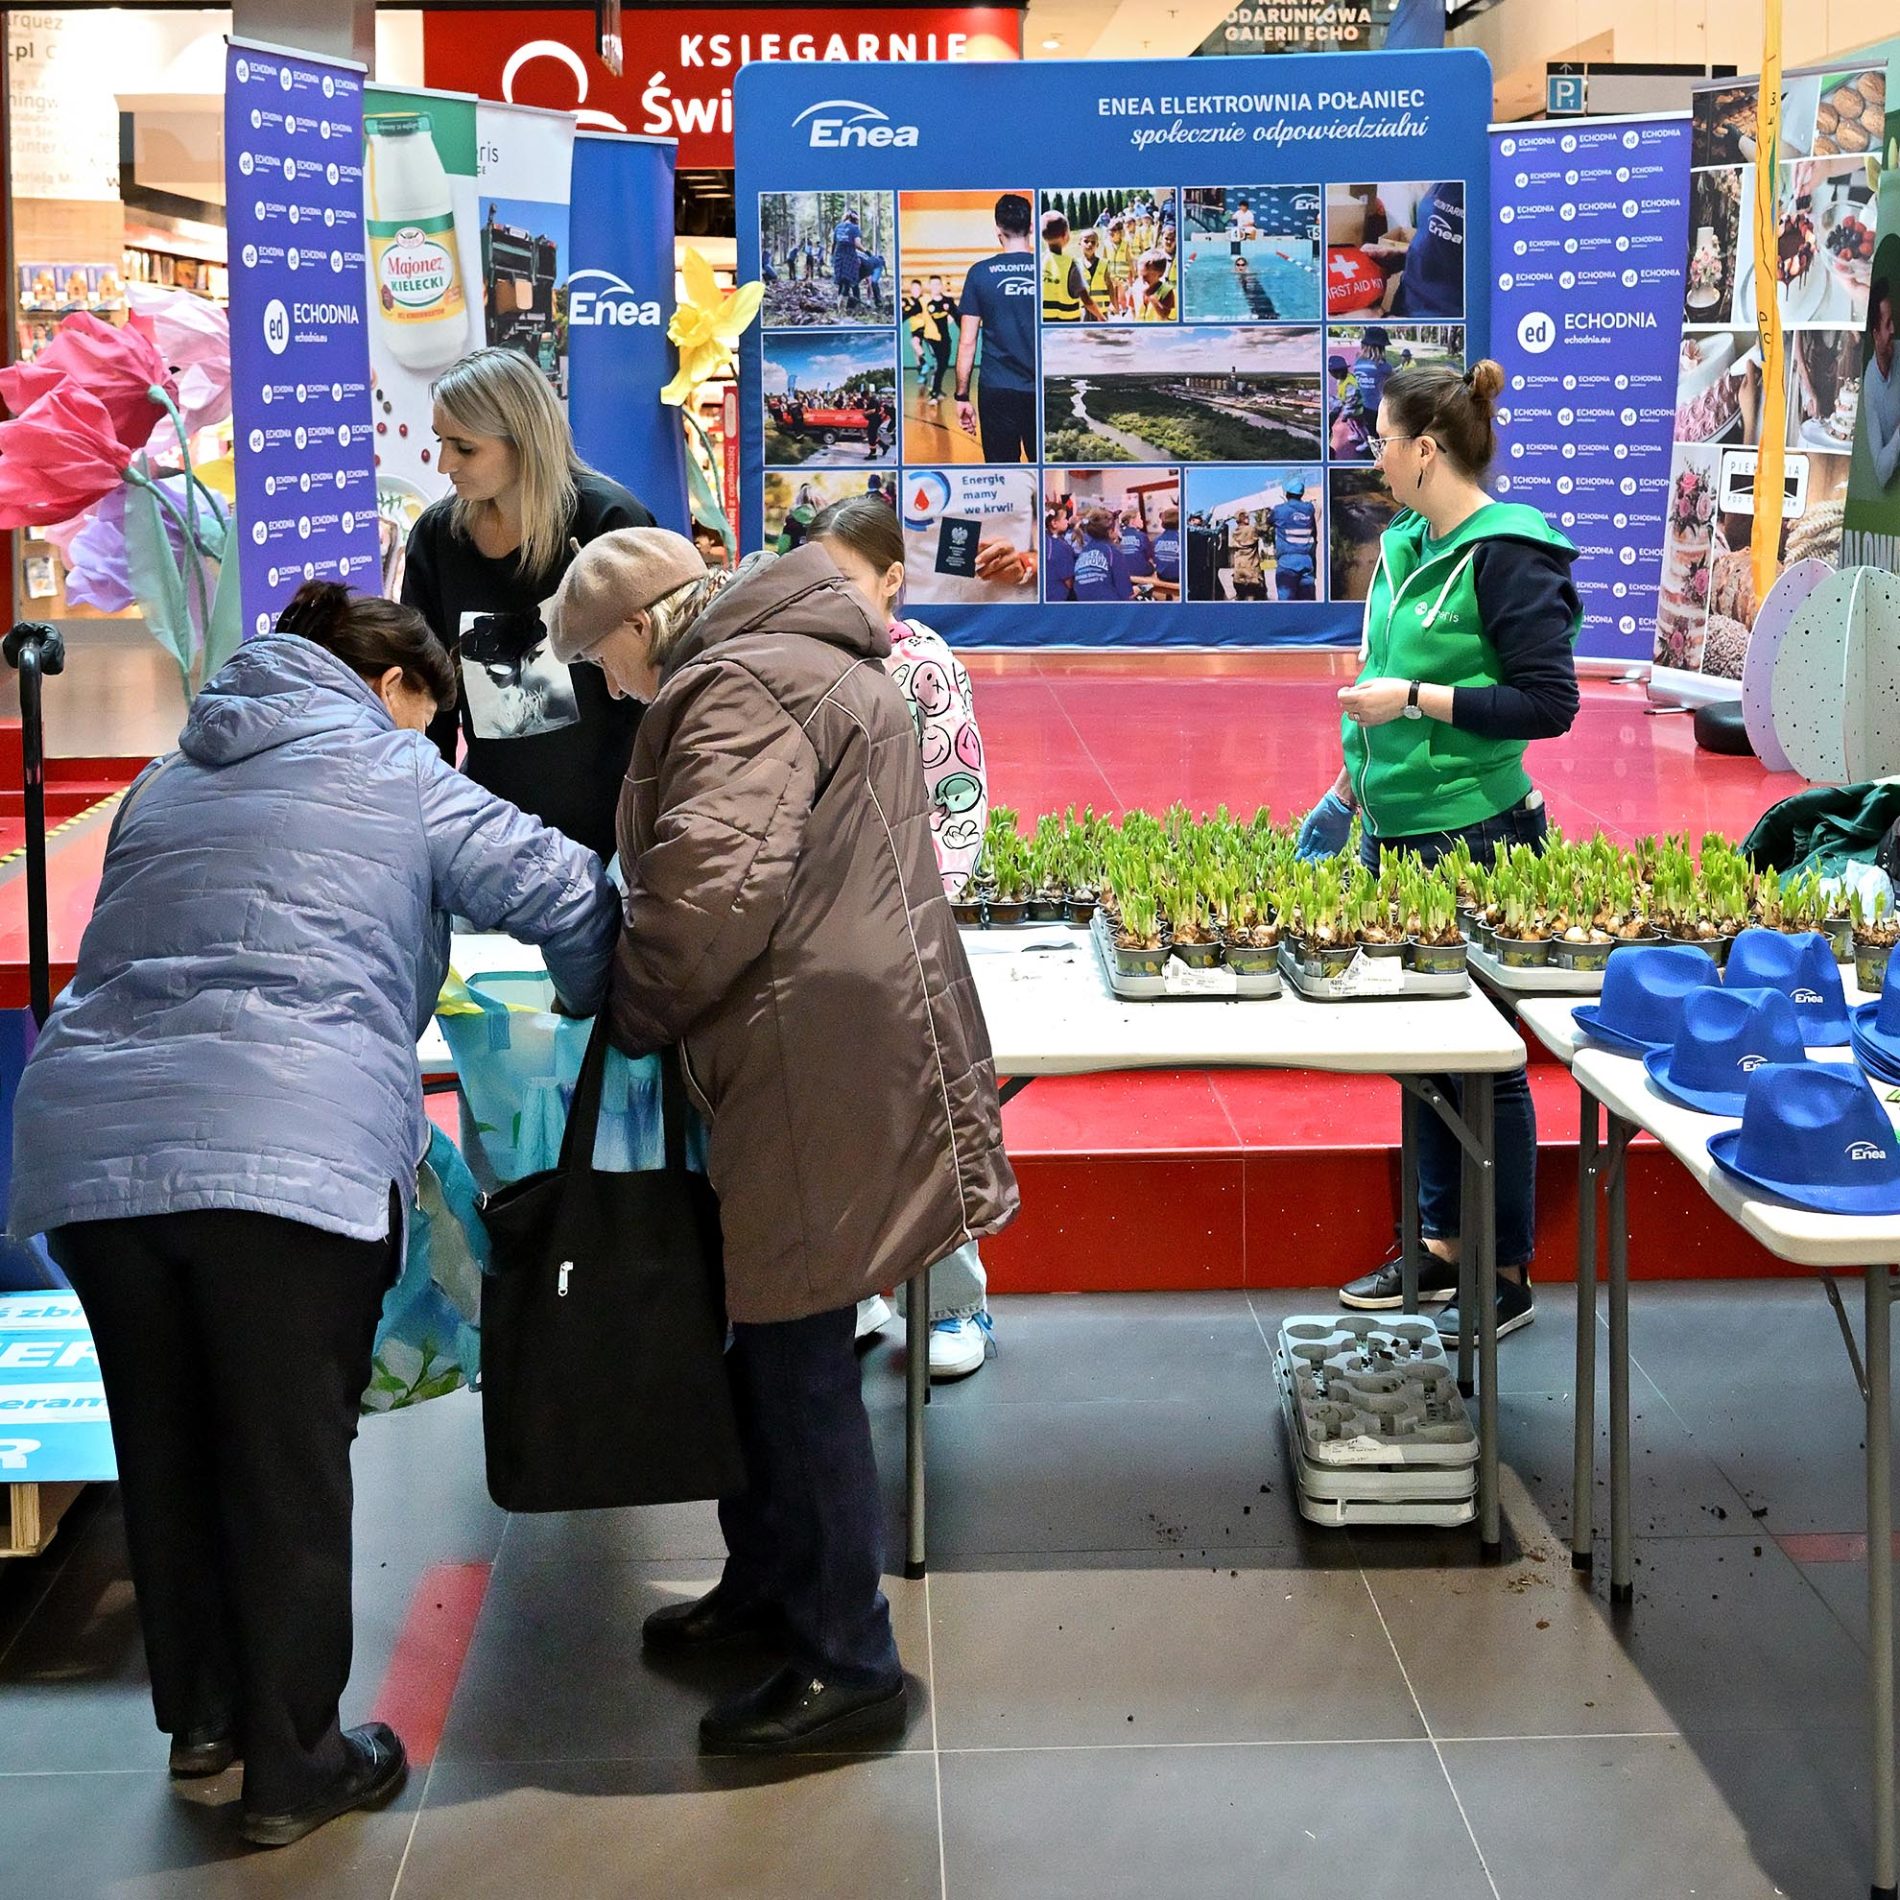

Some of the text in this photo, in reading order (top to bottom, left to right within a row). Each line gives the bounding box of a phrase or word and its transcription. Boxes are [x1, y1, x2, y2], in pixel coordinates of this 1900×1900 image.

[1226, 8, 1371, 24] ODARUNKOWA
[1225, 26, 1360, 41] GALERII ECHO
[1556, 80, 1574, 107] P
[641, 71, 732, 133] Świ
[1099, 90, 1425, 116] ENEA ELEKTROWNIA POŁANIEC
[1130, 112, 1430, 150] społecznie odpowiedzialni
[1642, 129, 1680, 138] ECHODNIA
[1519, 138, 1556, 146] ECHODNIA
[1580, 133, 1617, 142] ECHODNIA
[480, 141, 498, 162] ris
[1517, 205, 1554, 213] ECHODNIA
[1578, 202, 1616, 210] ECHODNIA
[1641, 199, 1680, 207] ECHODNIA
[1428, 220, 1463, 244] Enea
[388, 257, 444, 279] Majonez
[1640, 269, 1680, 277] ECHODNIA
[1516, 273, 1554, 281] ECHODNIA
[1578, 271, 1616, 279] ECHODNIA
[391, 276, 444, 292] KIELECKI
[1328, 284, 1350, 299] IRST
[1354, 280, 1370, 292] AID
[569, 292, 660, 326] Enea
[270, 304, 359, 340] ed ECHODNIA
[1526, 312, 1657, 342] ed ECHODNIA
[1564, 336, 1611, 344] echodnia.eu
[962, 474, 1005, 486] Energię
[1513, 476, 1551, 484] ECHODNIA
[963, 490, 997, 500] mamy
[984, 502, 1013, 513] krwi!
[1583, 615, 1613, 623] HODNIA
[16, 1306, 82, 1318] zbi
